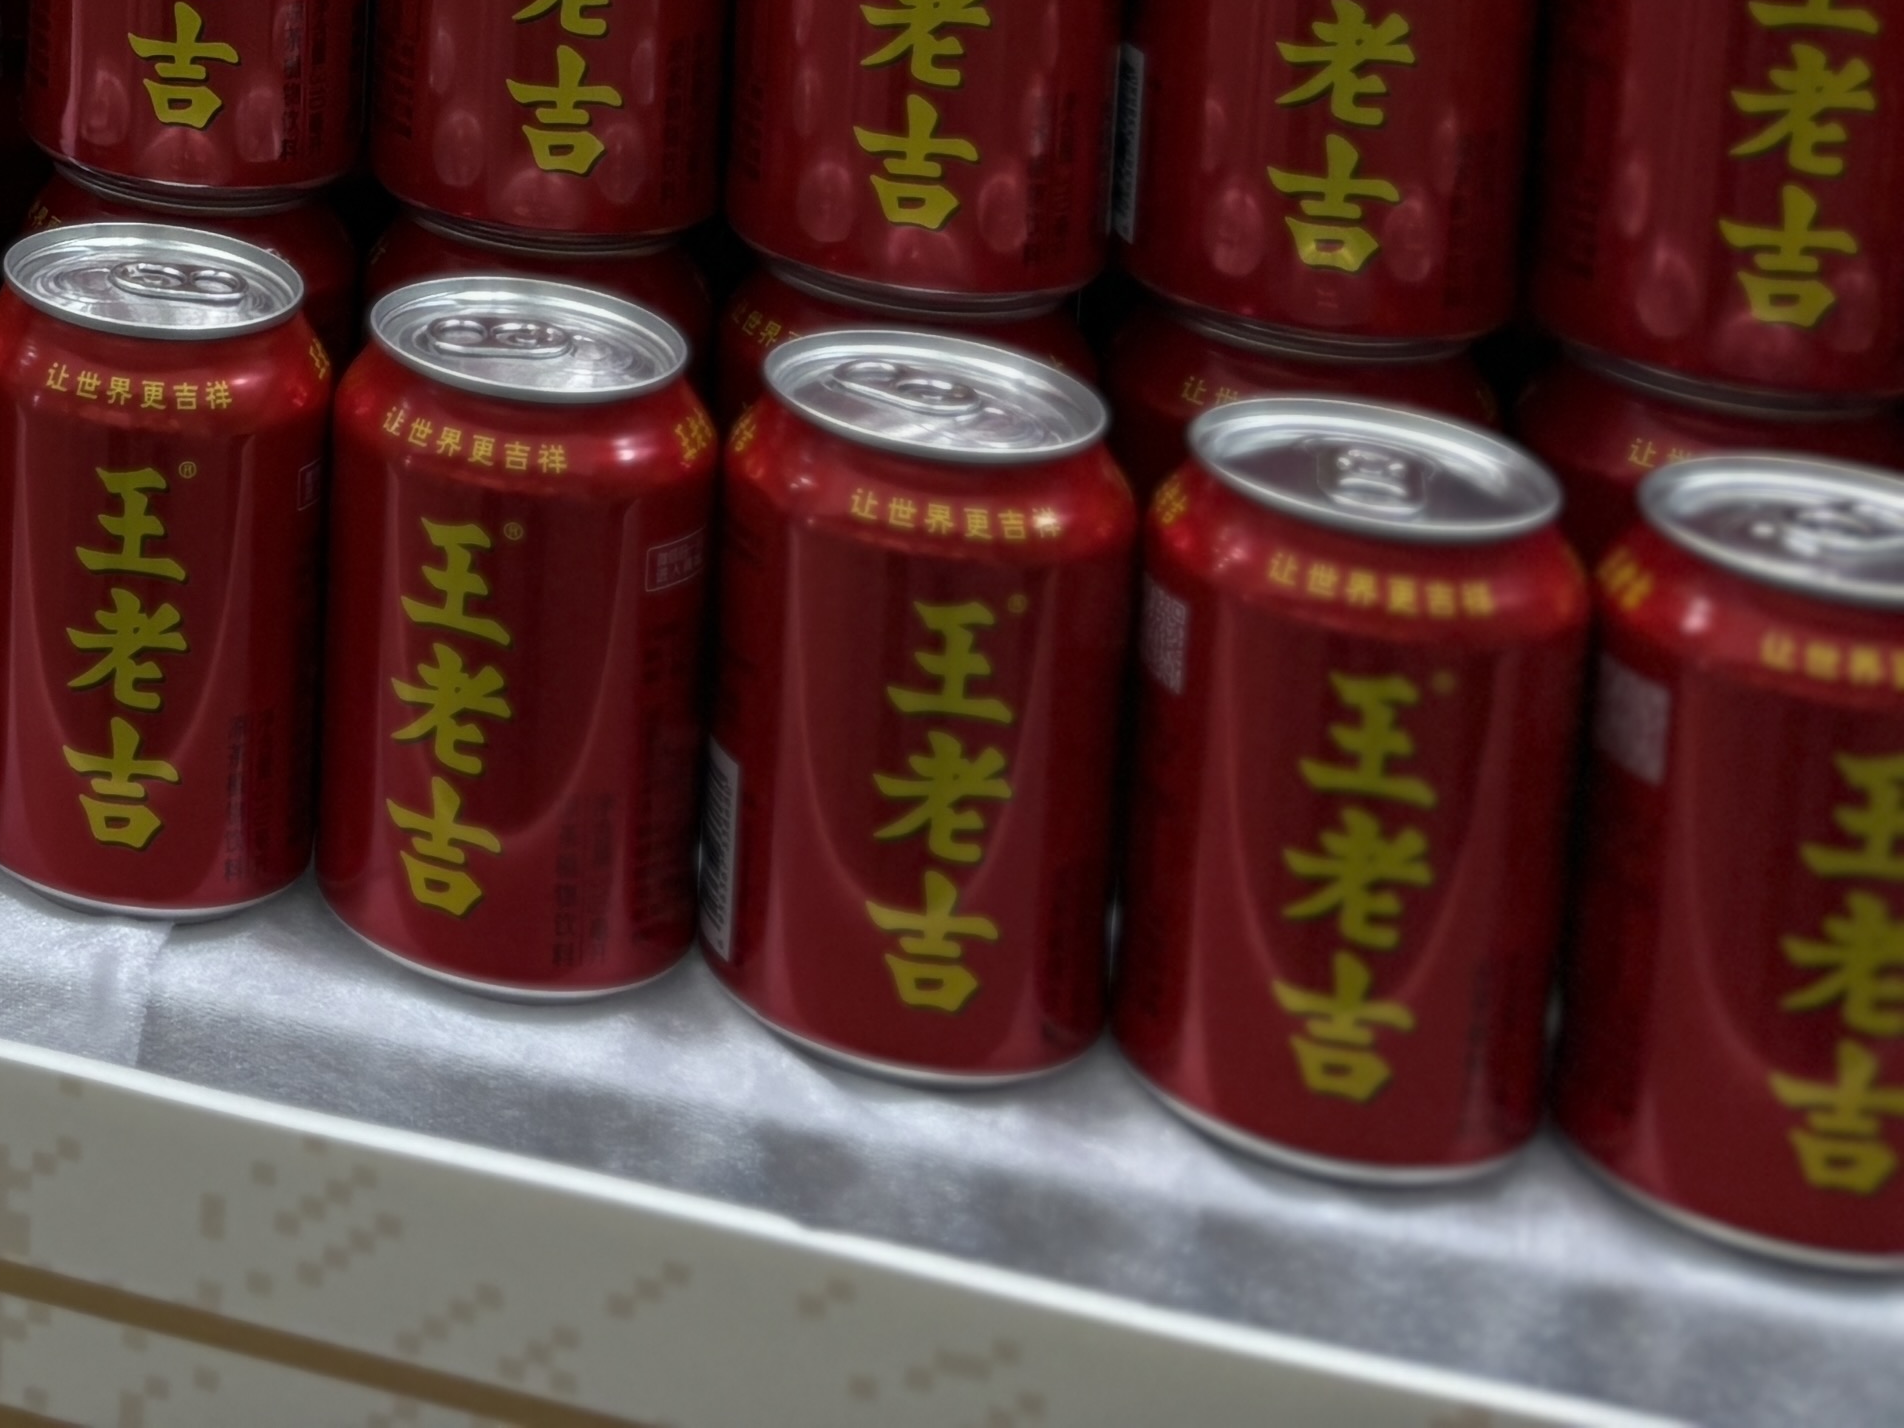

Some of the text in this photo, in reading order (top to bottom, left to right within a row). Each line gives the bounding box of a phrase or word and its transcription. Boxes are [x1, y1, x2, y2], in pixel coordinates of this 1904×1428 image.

[45, 362, 234, 411] 让世界更吉祥
[382, 407, 568, 475] 让世界更吉祥
[849, 488, 1064, 540] 让世界更吉祥
[62, 467, 188, 849] 王老吉
[387, 517, 514, 916] 王老吉
[866, 601, 1015, 1013] 王老吉
[1273, 673, 1436, 1102] 王老吉
[1770, 753, 1904, 1195] 王老吉
